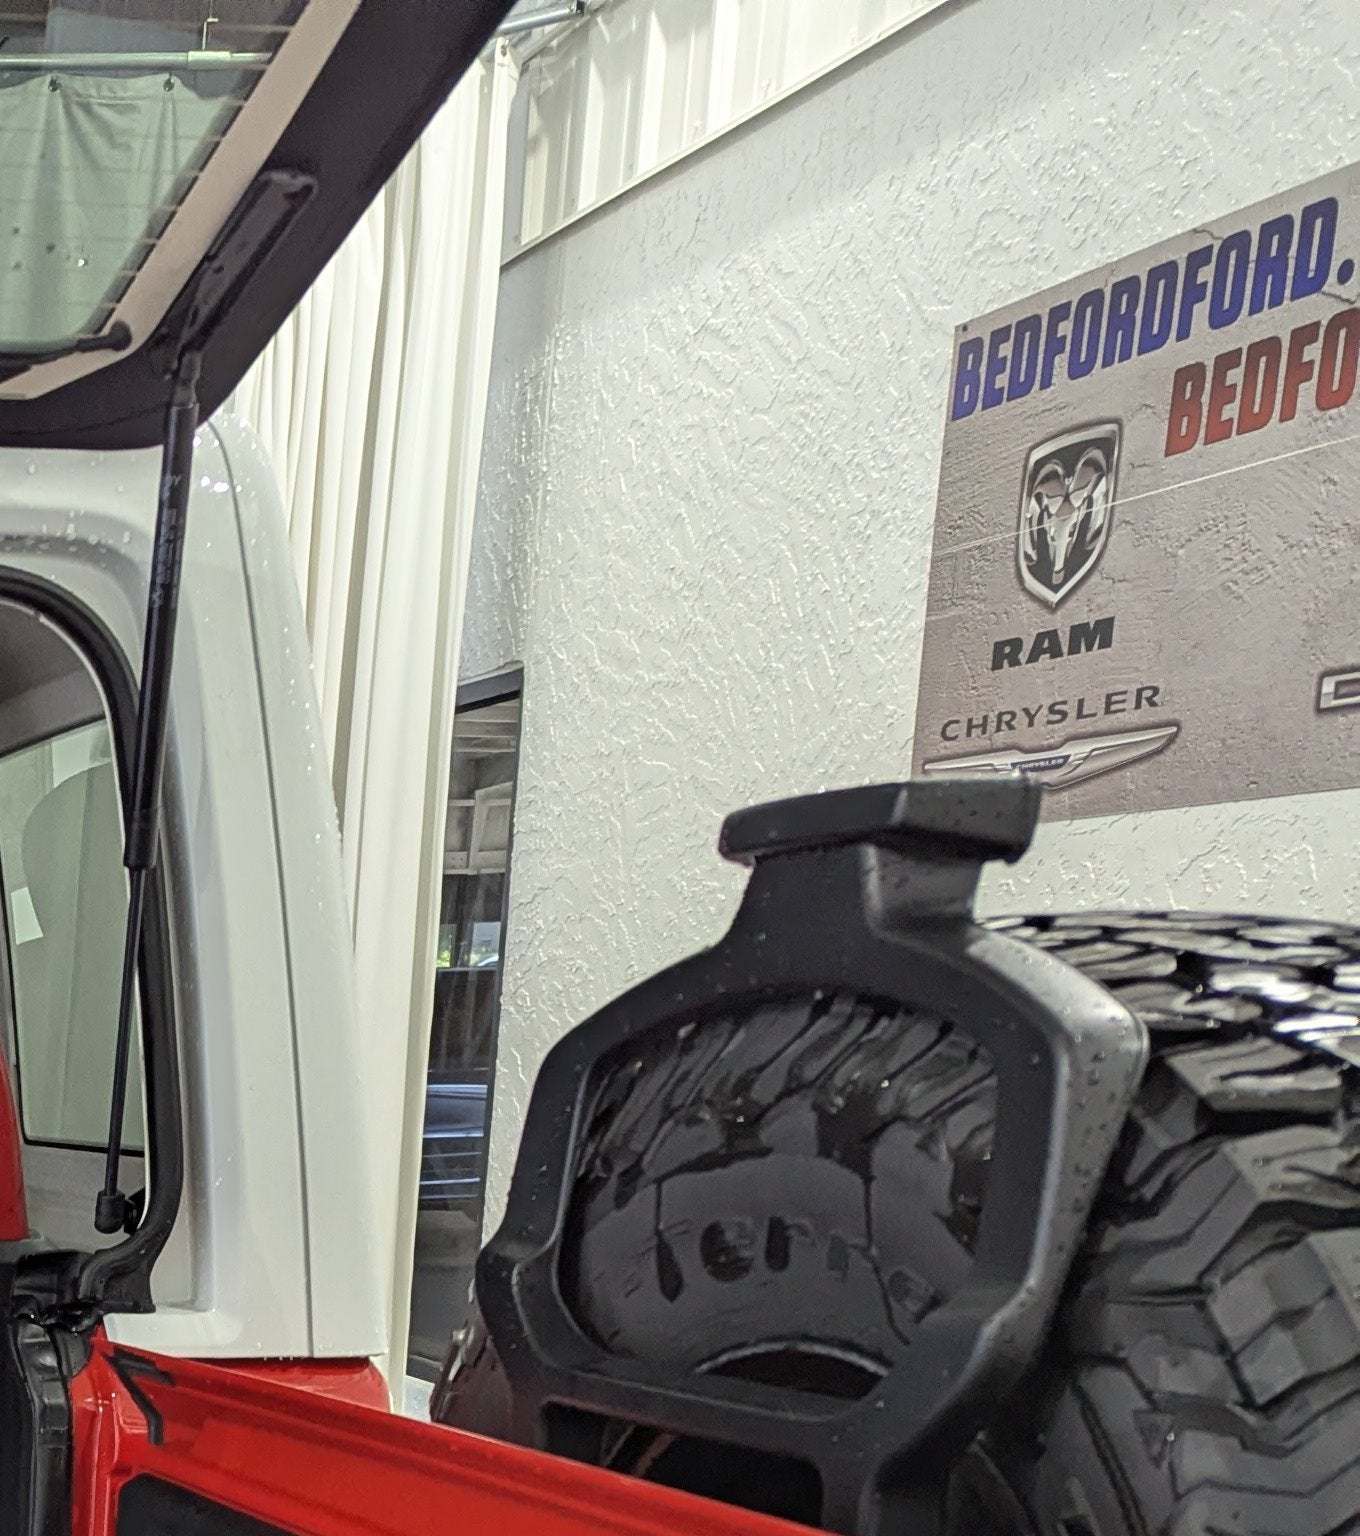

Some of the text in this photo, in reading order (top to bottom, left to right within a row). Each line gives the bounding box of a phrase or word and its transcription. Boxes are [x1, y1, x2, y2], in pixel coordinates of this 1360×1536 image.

[951, 197, 1355, 421] BEDFORDFORD.
[991, 616, 1115, 671] RAM
[940, 686, 1161, 741] CHRYSLER
